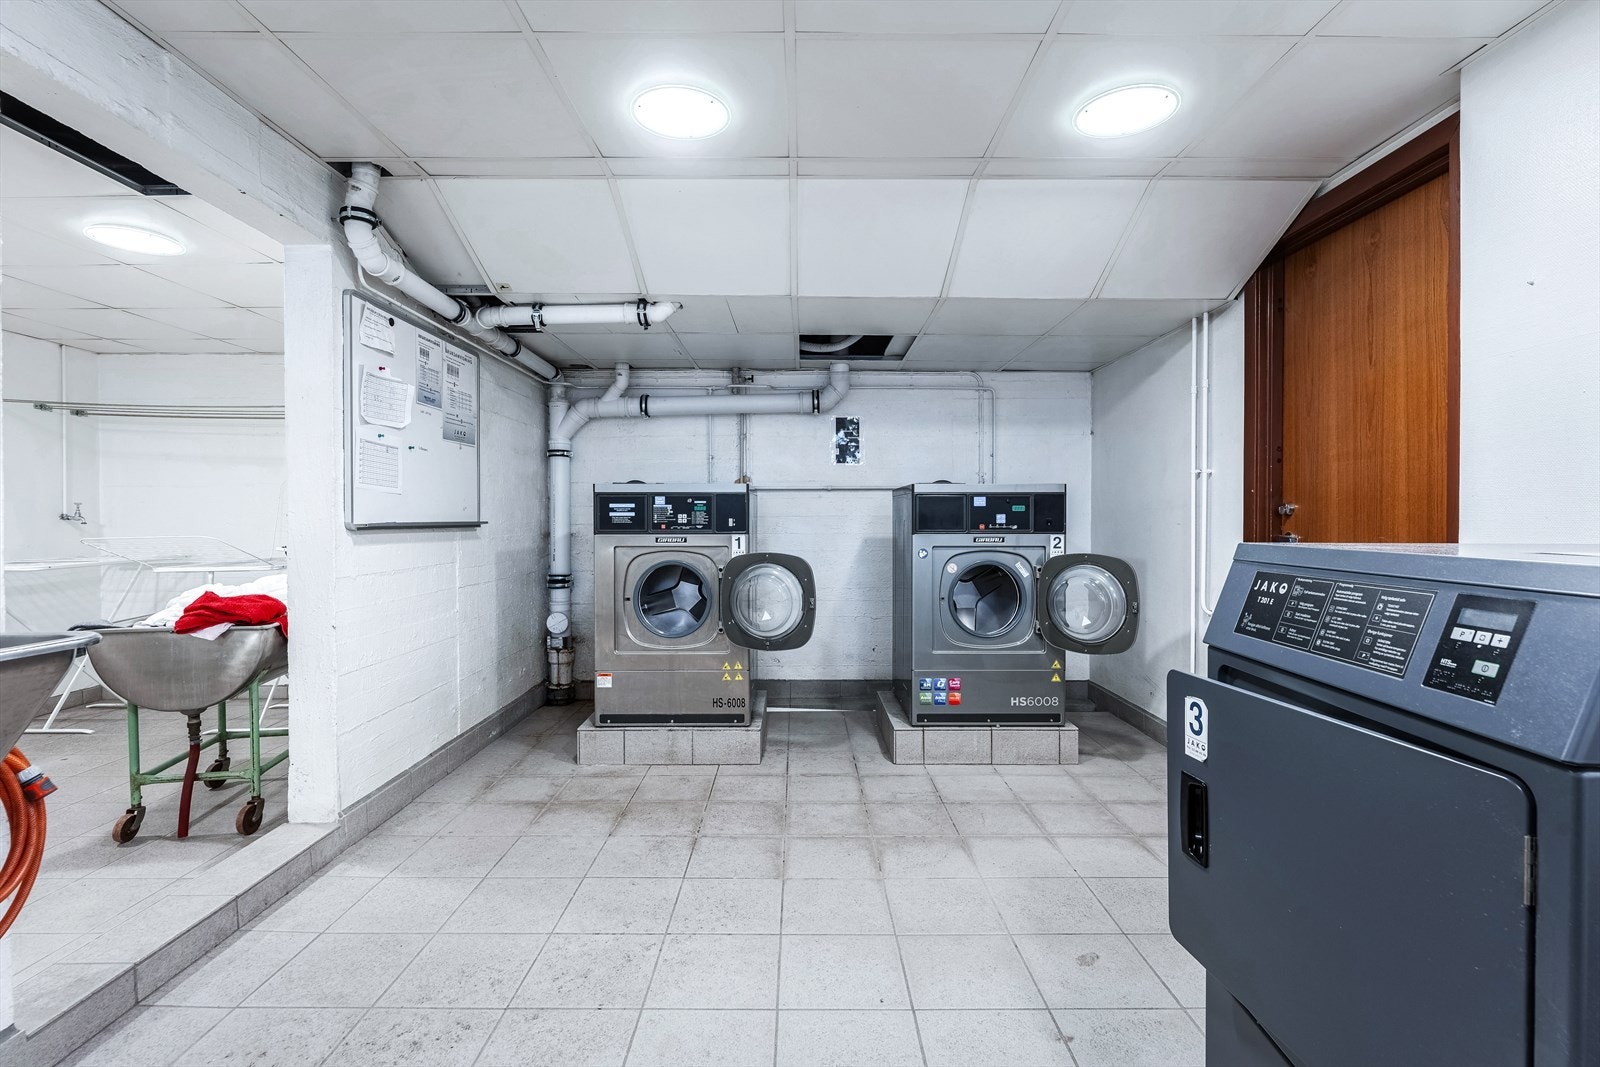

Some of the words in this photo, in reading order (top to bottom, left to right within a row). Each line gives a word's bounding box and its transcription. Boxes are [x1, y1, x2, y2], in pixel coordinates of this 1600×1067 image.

[734, 536, 741, 550] 1
[1052, 536, 1062, 549] 2
[1253, 579, 1288, 595] JAKO
[712, 697, 746, 708] HS-6008
[1010, 696, 1059, 706] HS6008
[1189, 701, 1203, 737] 3
[1187, 738, 1206, 751] JAKO
